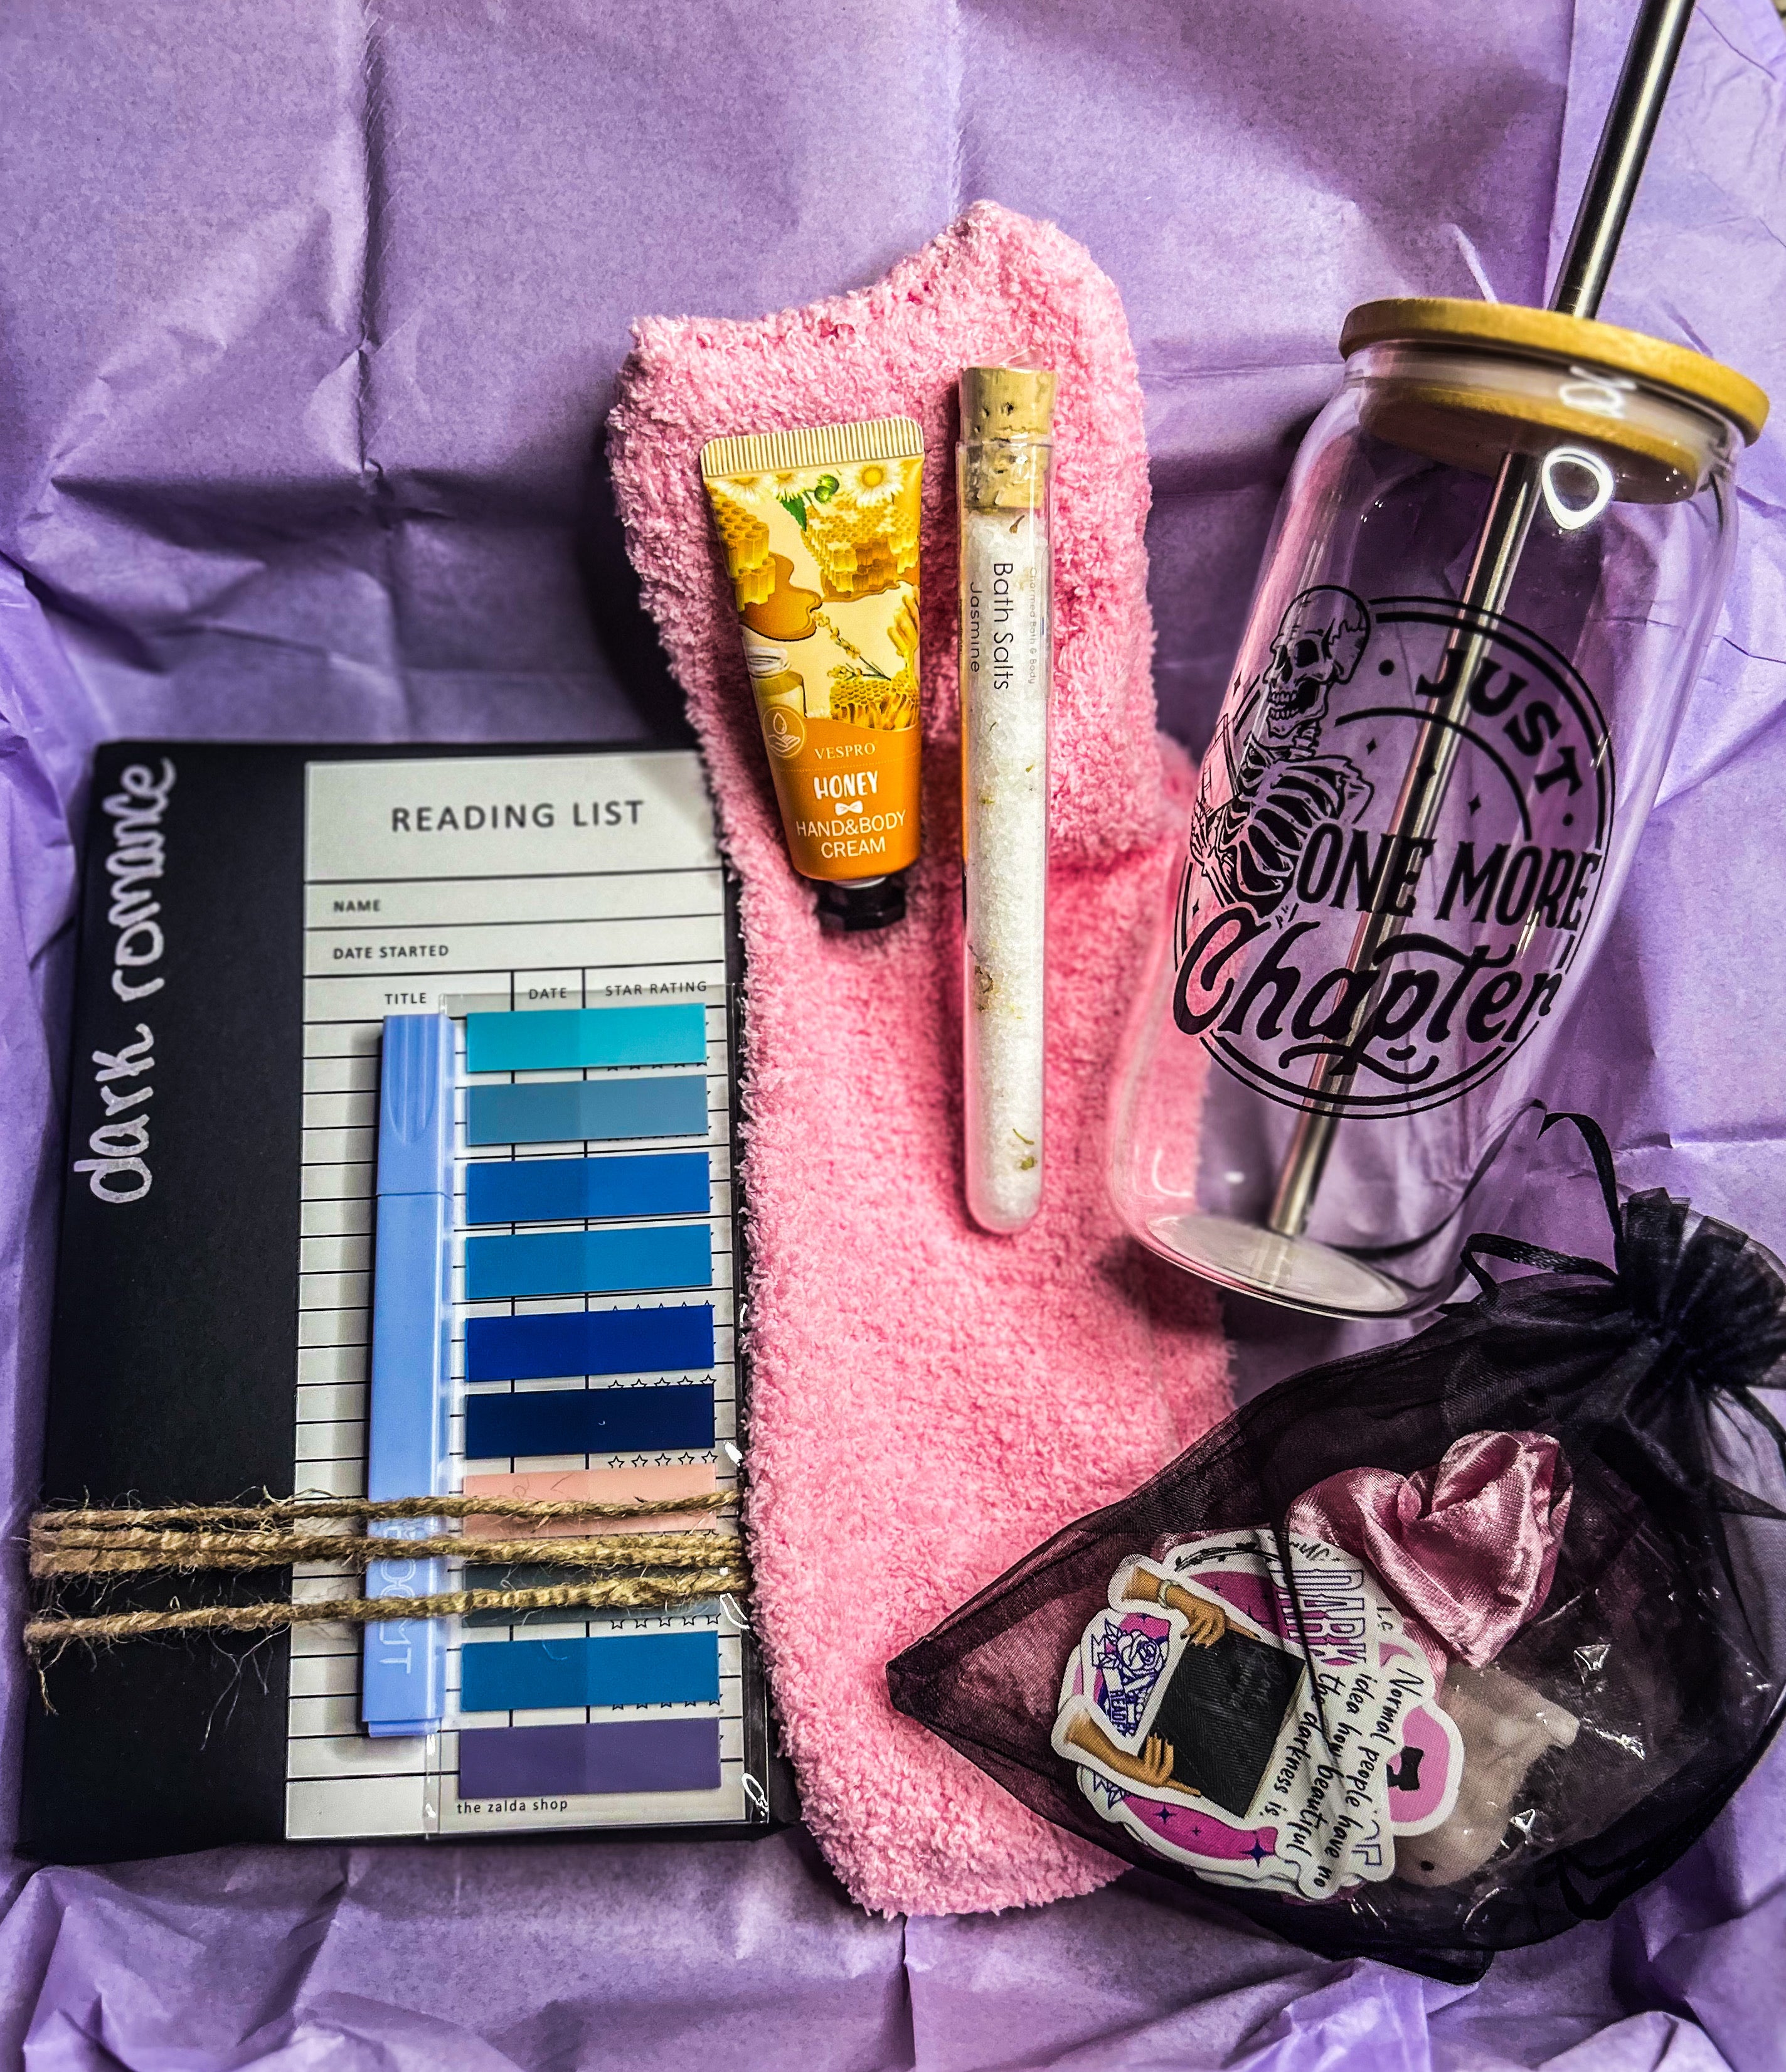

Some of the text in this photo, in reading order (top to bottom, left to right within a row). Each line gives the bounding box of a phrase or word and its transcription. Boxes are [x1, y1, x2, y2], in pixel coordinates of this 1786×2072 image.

[970, 582, 983, 673] Jasmine
[993, 563, 1014, 690] Bath Salts
[1028, 660, 1037, 685] Body
[1416, 648, 1583, 803] JUST
[814, 742, 876, 760] VESPRO
[813, 770, 878, 800] HONEY
[391, 800, 644, 833] READING LIST
[795, 809, 906, 838] HAND&BODY
[821, 836, 886, 859] CREAM
[1295, 824, 1602, 931] ONE MORE
[333, 899, 380, 912] NAME
[333, 944, 449, 959] DATE STARTED
[74, 757, 176, 1204] dark romance
[529, 986, 567, 1000] DATE
[605, 981, 708, 996] STAR RATING
[1173, 902, 1563, 1084] Chapter
[385, 992, 427, 1005] TITLE
[1269, 1569, 1367, 1664] DARK
[1311, 1672, 1346, 1706] the
[1370, 1668, 1424, 1745] Normal
[1274, 1711, 1323, 1795] darkness
[1286, 1674, 1378, 1858] idea how beautiful
[1345, 1746, 1379, 1808] people
[457, 1798, 568, 1814] the zalda shop
[1324, 1814, 1364, 1859] have
[1314, 1865, 1332, 1888] no
